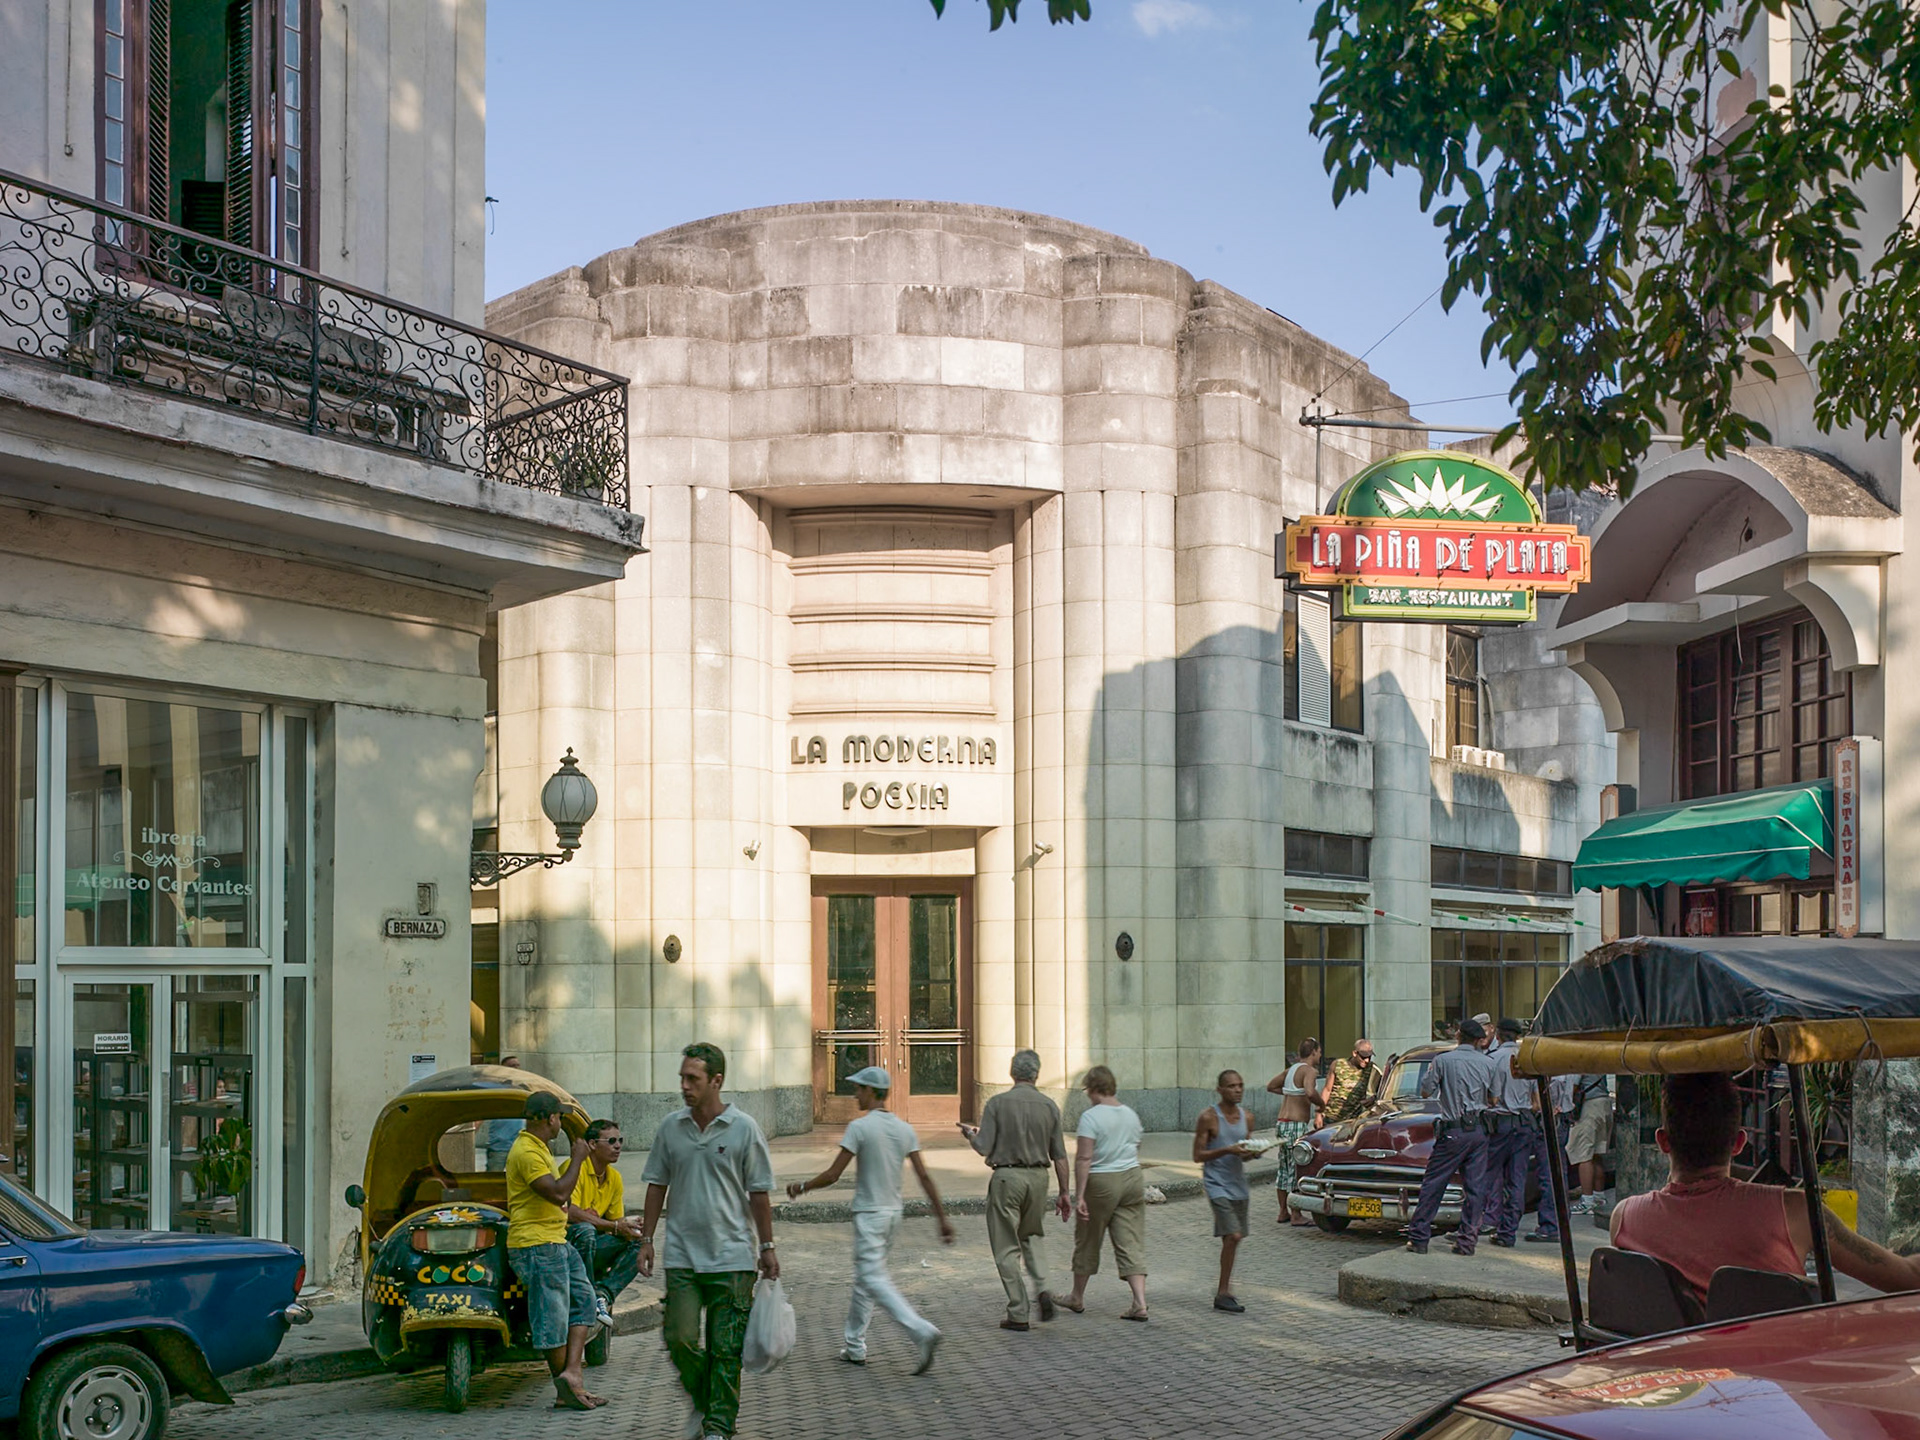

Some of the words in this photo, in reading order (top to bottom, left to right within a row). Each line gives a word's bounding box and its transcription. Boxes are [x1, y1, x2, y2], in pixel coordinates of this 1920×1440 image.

[1312, 532, 1342, 568] LA
[1355, 530, 1421, 569] PIÑA
[1435, 536, 1475, 572] DE
[1485, 539, 1571, 575] PLATA
[790, 735, 828, 765] LA
[842, 734, 997, 765] MODERNA
[842, 781, 949, 810] POESIA
[1841, 759, 1853, 917] RESTAURANT
[75, 872, 151, 891] Ateneo
[157, 875, 254, 896] Cervantes
[393, 921, 440, 934] BERNAZA
[416, 1264, 486, 1284] COCO
[425, 1293, 472, 1306] TAXI
